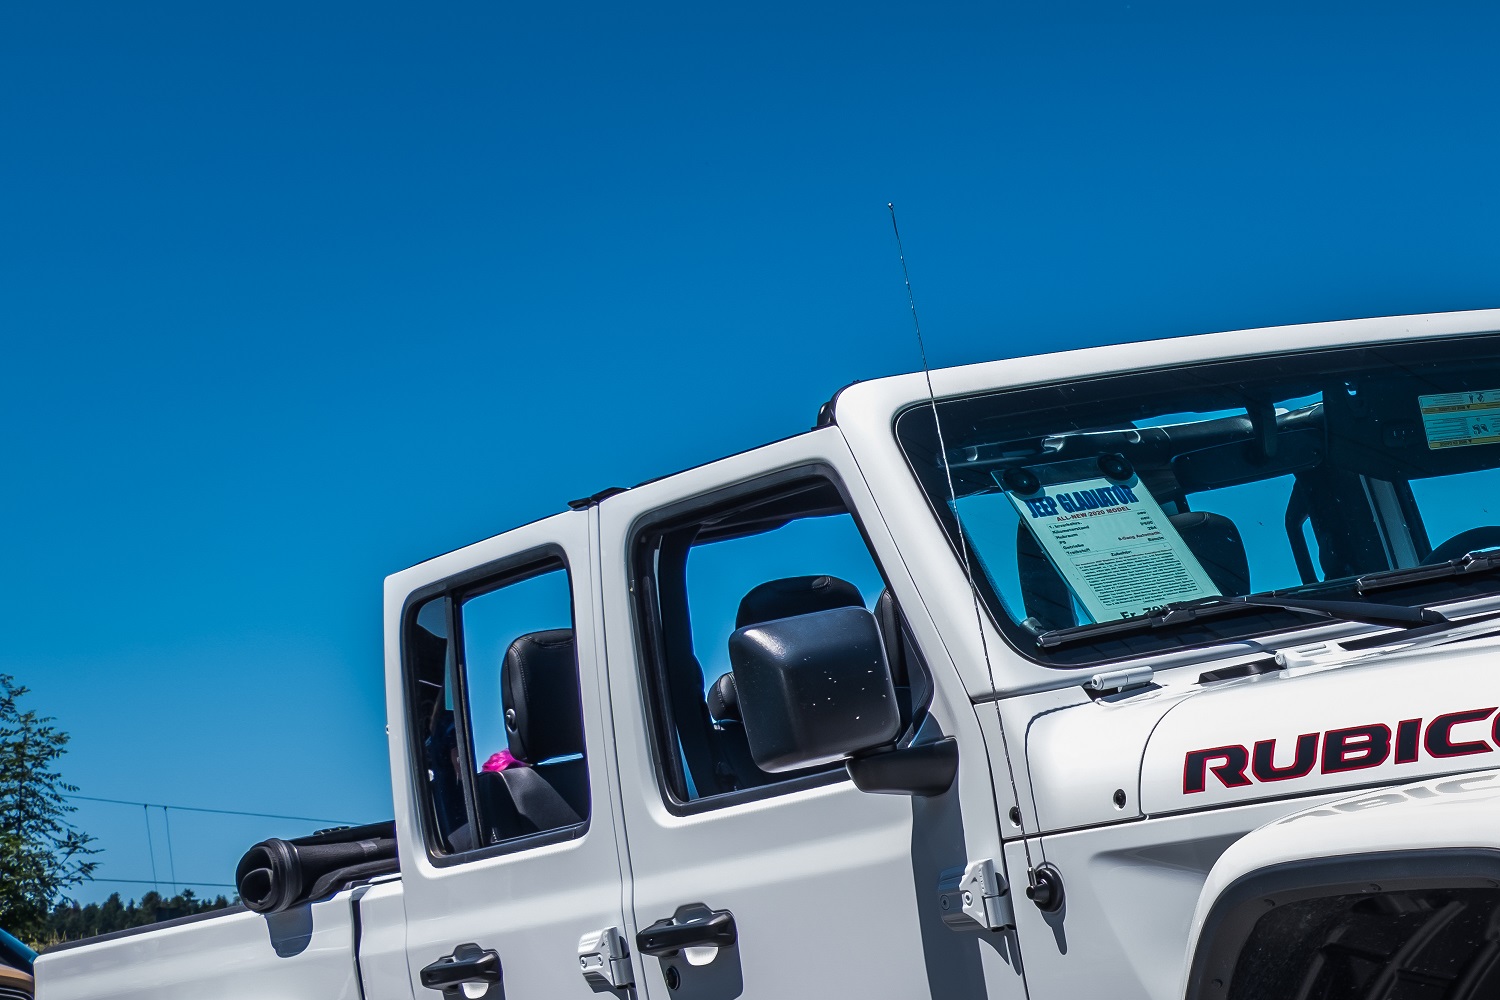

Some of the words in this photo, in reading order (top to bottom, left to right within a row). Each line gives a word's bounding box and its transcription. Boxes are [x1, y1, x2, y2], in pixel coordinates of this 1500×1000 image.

[1024, 496, 1058, 519] JEEP
[1056, 484, 1140, 514] GLADIATOR
[1056, 511, 1088, 522] ALL-NEW
[1088, 508, 1106, 518] 2020
[1105, 505, 1132, 515] MODEL
